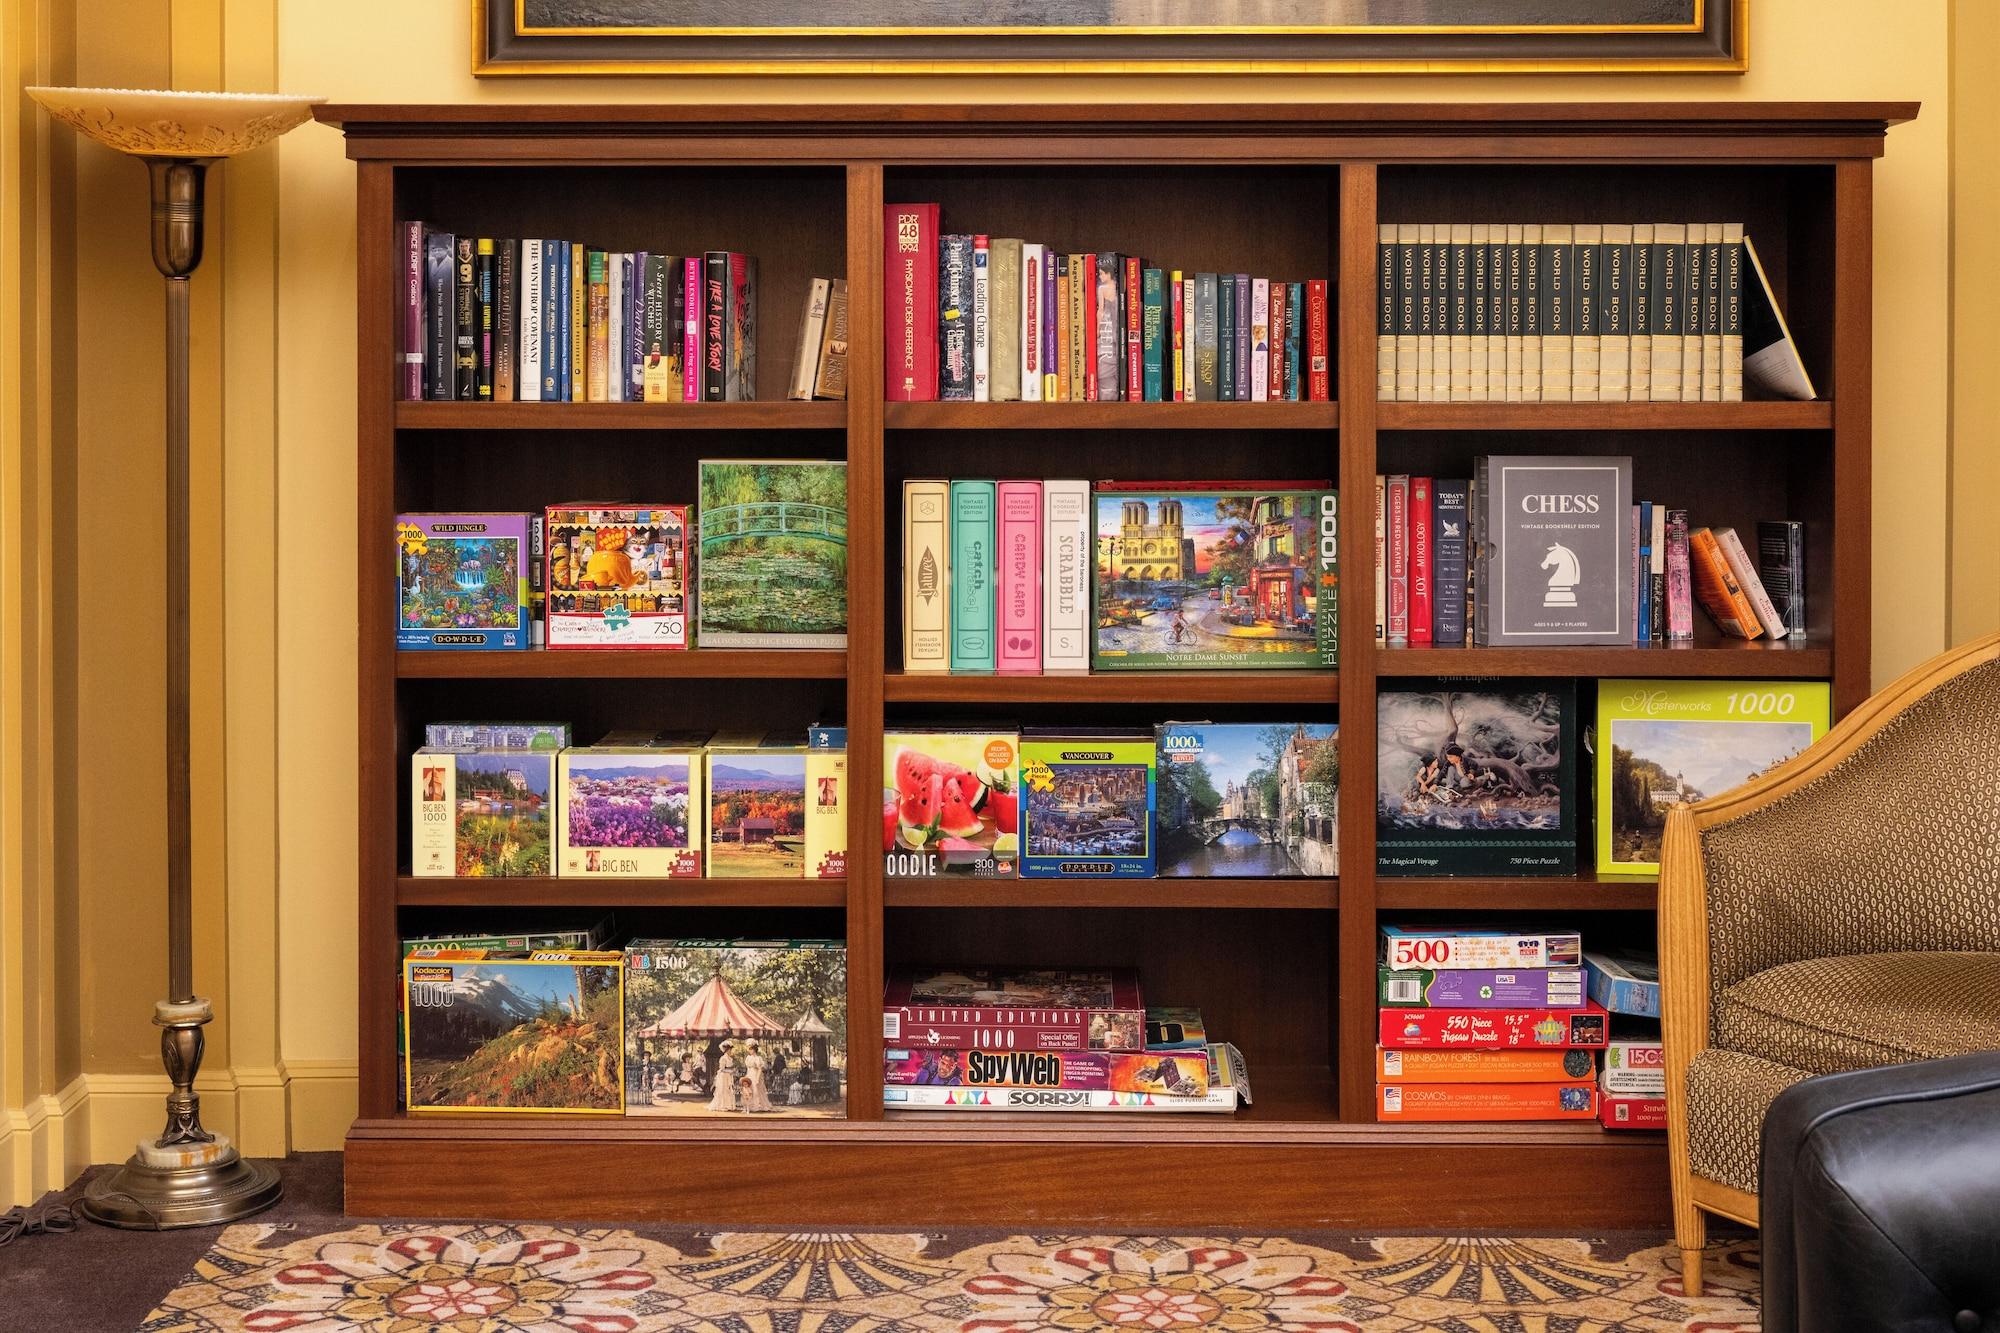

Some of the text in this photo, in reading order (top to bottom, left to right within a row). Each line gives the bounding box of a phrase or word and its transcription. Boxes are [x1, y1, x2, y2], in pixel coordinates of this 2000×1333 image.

[898, 214, 919, 224] PDR
[899, 225, 918, 238] 48
[410, 226, 418, 275] SPACE ADRIFT
[898, 243, 919, 253] 1994
[502, 249, 510, 336] SISTER SOULJAH
[709, 279, 722, 303] LIKE
[947, 263, 962, 306] Johnson
[530, 242, 538, 365] THE WINTHROP COVENANT
[646, 288, 655, 329] WITCHES
[1185, 283, 1193, 314] HEYER
[905, 259, 913, 369] PHYSICIANS' DESK REFERENCE
[975, 278, 987, 348] Leading Change
[1152, 304, 1162, 324] PETER
[1204, 304, 1213, 343] KRIEGER
[1312, 296, 1322, 329] CROSSED
[1404, 296, 1412, 331] BOOK
[1638, 296, 1646, 331] BOOK
[709, 314, 722, 341] LOVE
[1144, 304, 1154, 350] STARCATCHERS
[1273, 317, 1282, 339] Potion
[1100, 320, 1113, 361] HEIR
[708, 341, 722, 372] STORY
[1204, 352, 1212, 386] JONES
[1521, 494, 1599, 514] CHESS
[434, 524, 484, 532] WILD JUNGLE
[1394, 515, 1401, 524] IN
[403, 530, 423, 539] 1000
[533, 519, 541, 553] 1000
[1321, 495, 1337, 570] 1000
[973, 541, 984, 590] catch
[1394, 540, 1402, 573] WEATHER
[1416, 522, 1427, 598] JOY MIXOLOGY
[963, 546, 979, 613] phrase!
[1014, 533, 1026, 618] CANDY LAND
[1059, 535, 1074, 614] SCRABBLE
[1759, 597, 1772, 623] Collins
[654, 622, 683, 635] 750
[1328, 589, 1337, 665] PUZZLE
[1620, 689, 1712, 715] Masterworks
[1727, 692, 1795, 715] 1000
[1165, 736, 1196, 748] 1000
[1031, 766, 1049, 774] 1000
[423, 803, 446, 812] BIG BEN
[423, 812, 447, 822] 1000
[816, 806, 838, 814] BIG BEN
[602, 860, 638, 872] BIG BEN
[679, 859, 695, 867] 1000
[887, 854, 937, 876] OODIE
[974, 858, 994, 869] 300
[1379, 857, 1439, 866] The Magical Voyage
[1509, 857, 1560, 865] 750 Piece Puzzle
[631, 955, 650, 969] MB
[654, 955, 687, 971] 1500
[1396, 940, 1450, 963] 500
[414, 967, 451, 975] Kodacolor
[413, 983, 454, 1008] 1000
[907, 1010, 1081, 1024] LIMITED EDITIONS
[1447, 1016, 1493, 1029] 550 Piece
[974, 1029, 1015, 1048] 1000
[1440, 1030, 1498, 1043] Jigsaw Puzzle
[1404, 1053, 1481, 1063] RAINBOW FOREST
[1009, 1091, 1091, 1106] SORRY!
[1404, 1091, 1447, 1101] COSMOS
